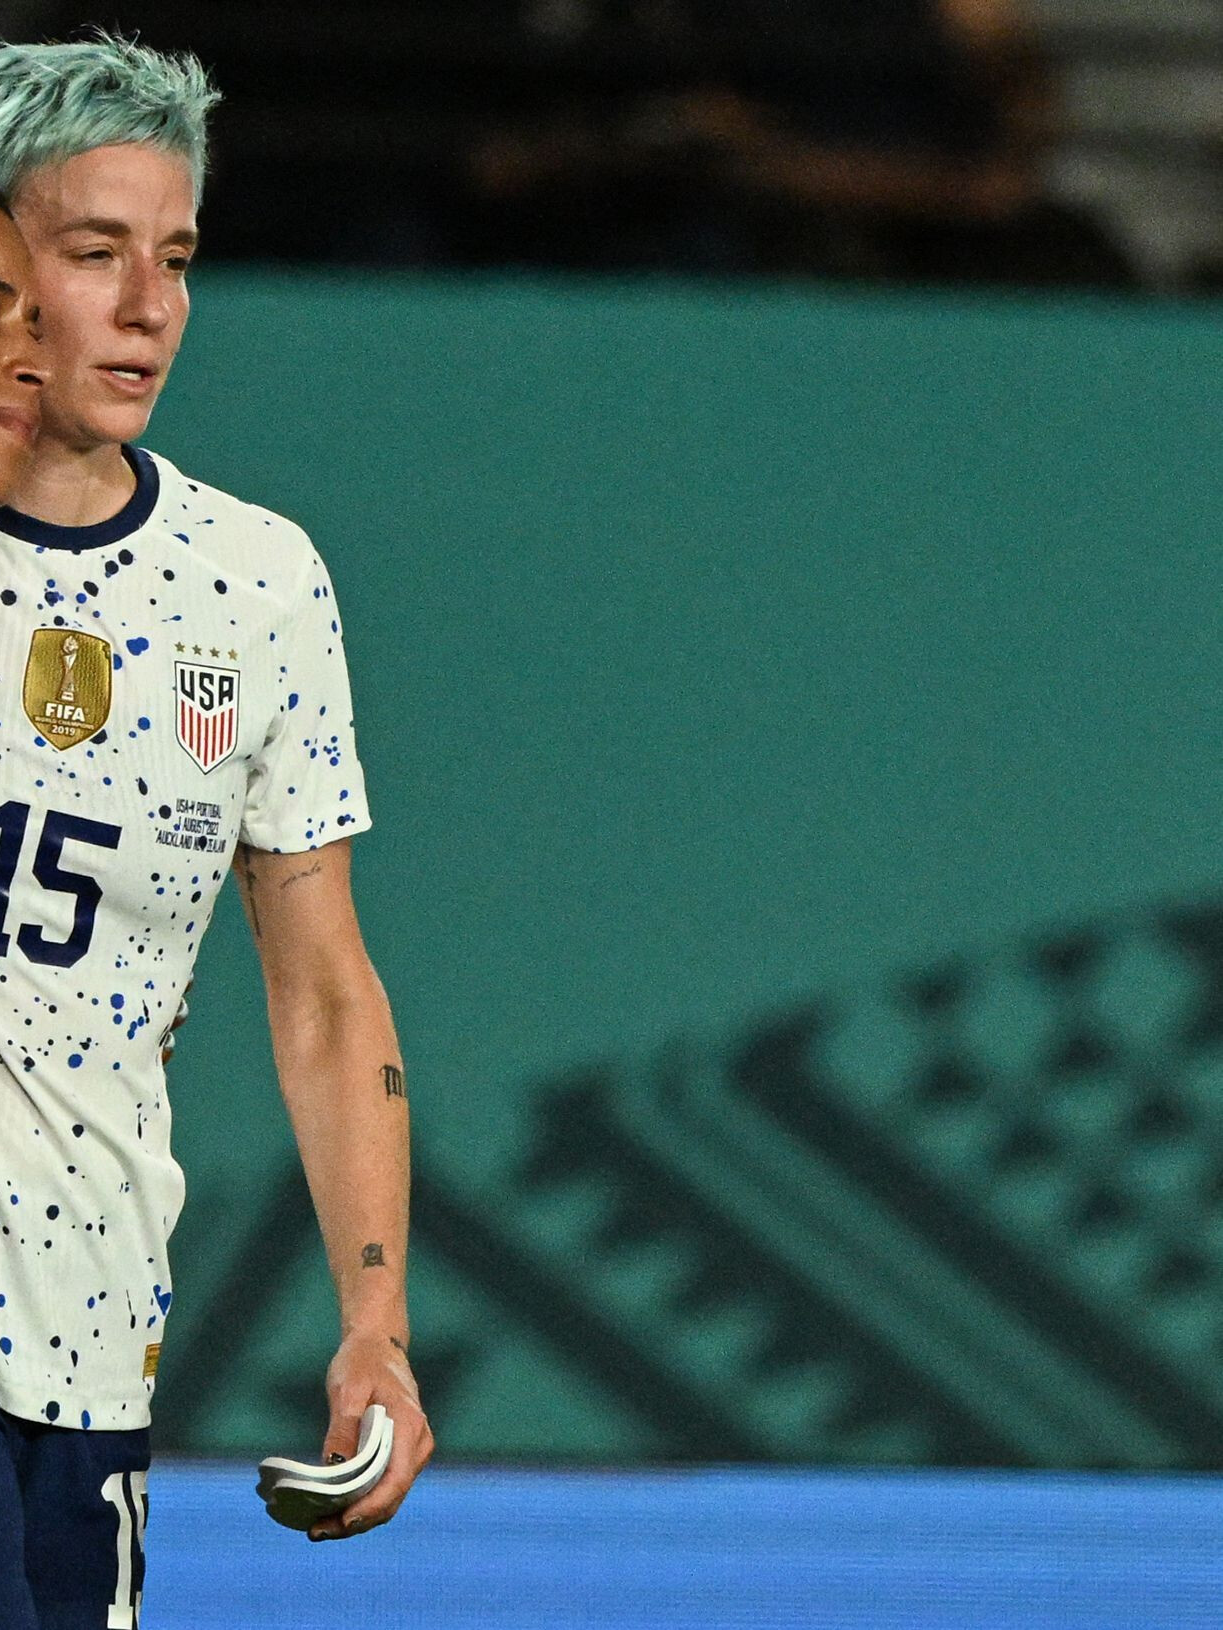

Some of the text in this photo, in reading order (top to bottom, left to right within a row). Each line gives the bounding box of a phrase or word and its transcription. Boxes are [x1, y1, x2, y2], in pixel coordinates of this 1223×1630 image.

[180, 668, 234, 712] USA
[45, 702, 86, 722] FIFA
[51, 725, 76, 737] 2019
[155, 829, 193, 850] AUCKLAND
